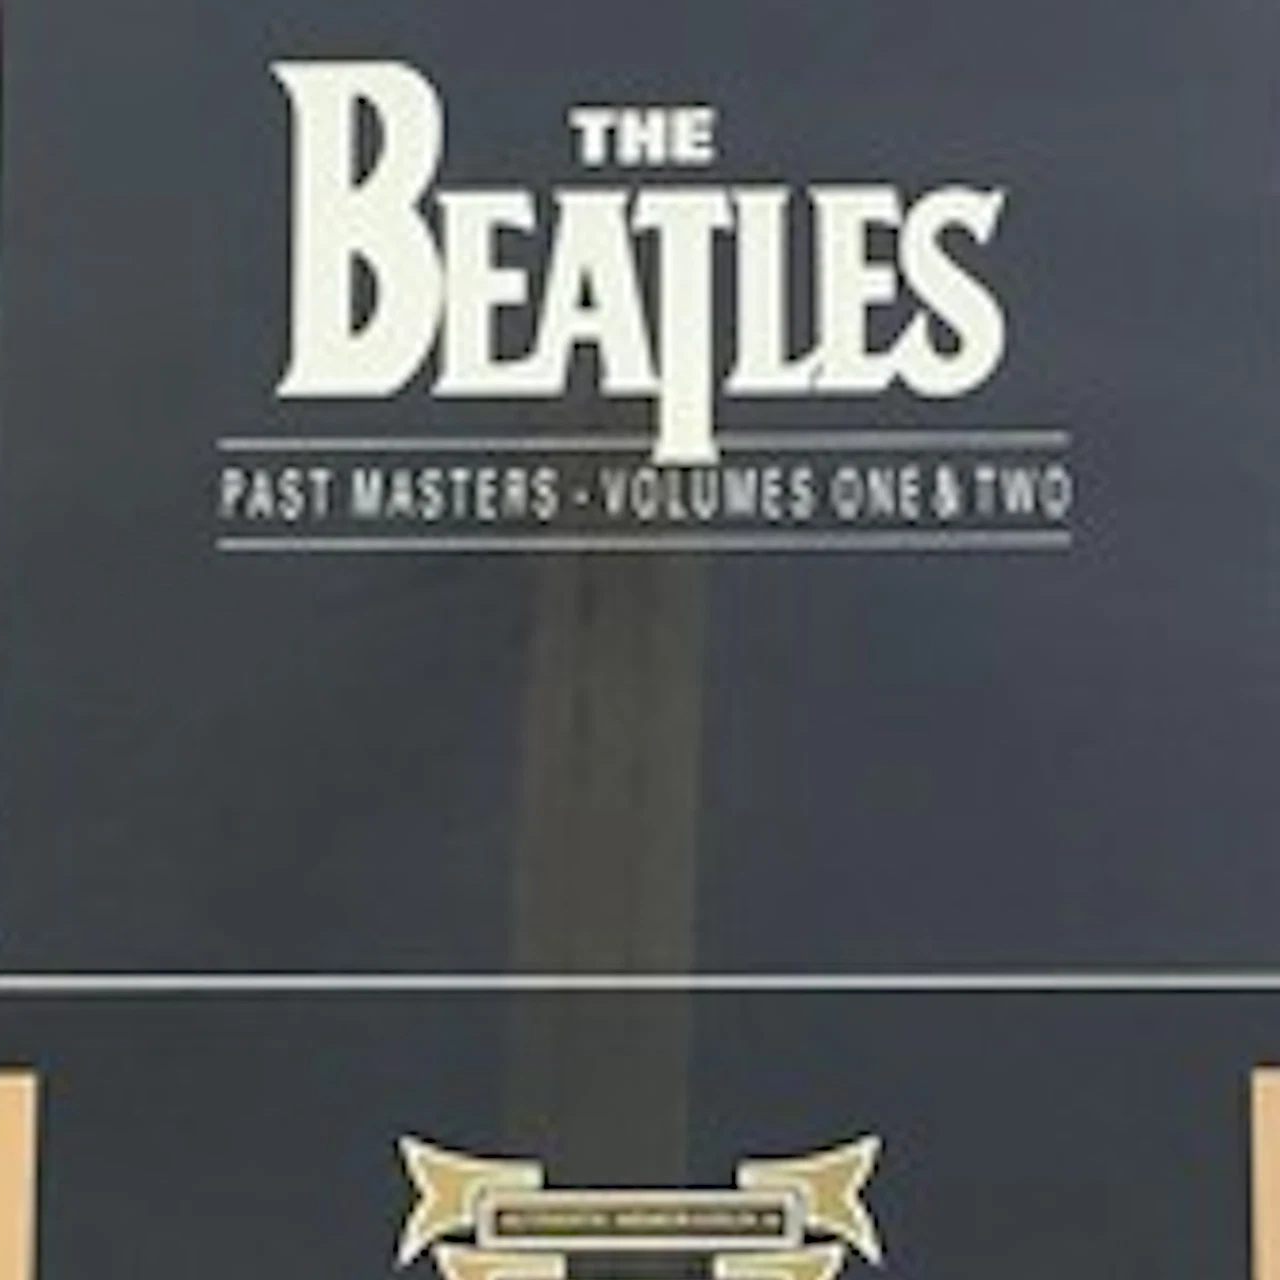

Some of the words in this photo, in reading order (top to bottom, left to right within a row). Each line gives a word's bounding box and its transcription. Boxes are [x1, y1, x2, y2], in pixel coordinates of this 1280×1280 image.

[569, 107, 717, 166] THE
[269, 60, 1008, 466] BEATLES
[222, 466, 334, 521] PAST
[349, 466, 559, 521] MASTERS
[599, 466, 816, 520] VOLUMES
[830, 465, 920, 519] ONE
[933, 465, 962, 519] &
[974, 465, 1074, 519] TWO
